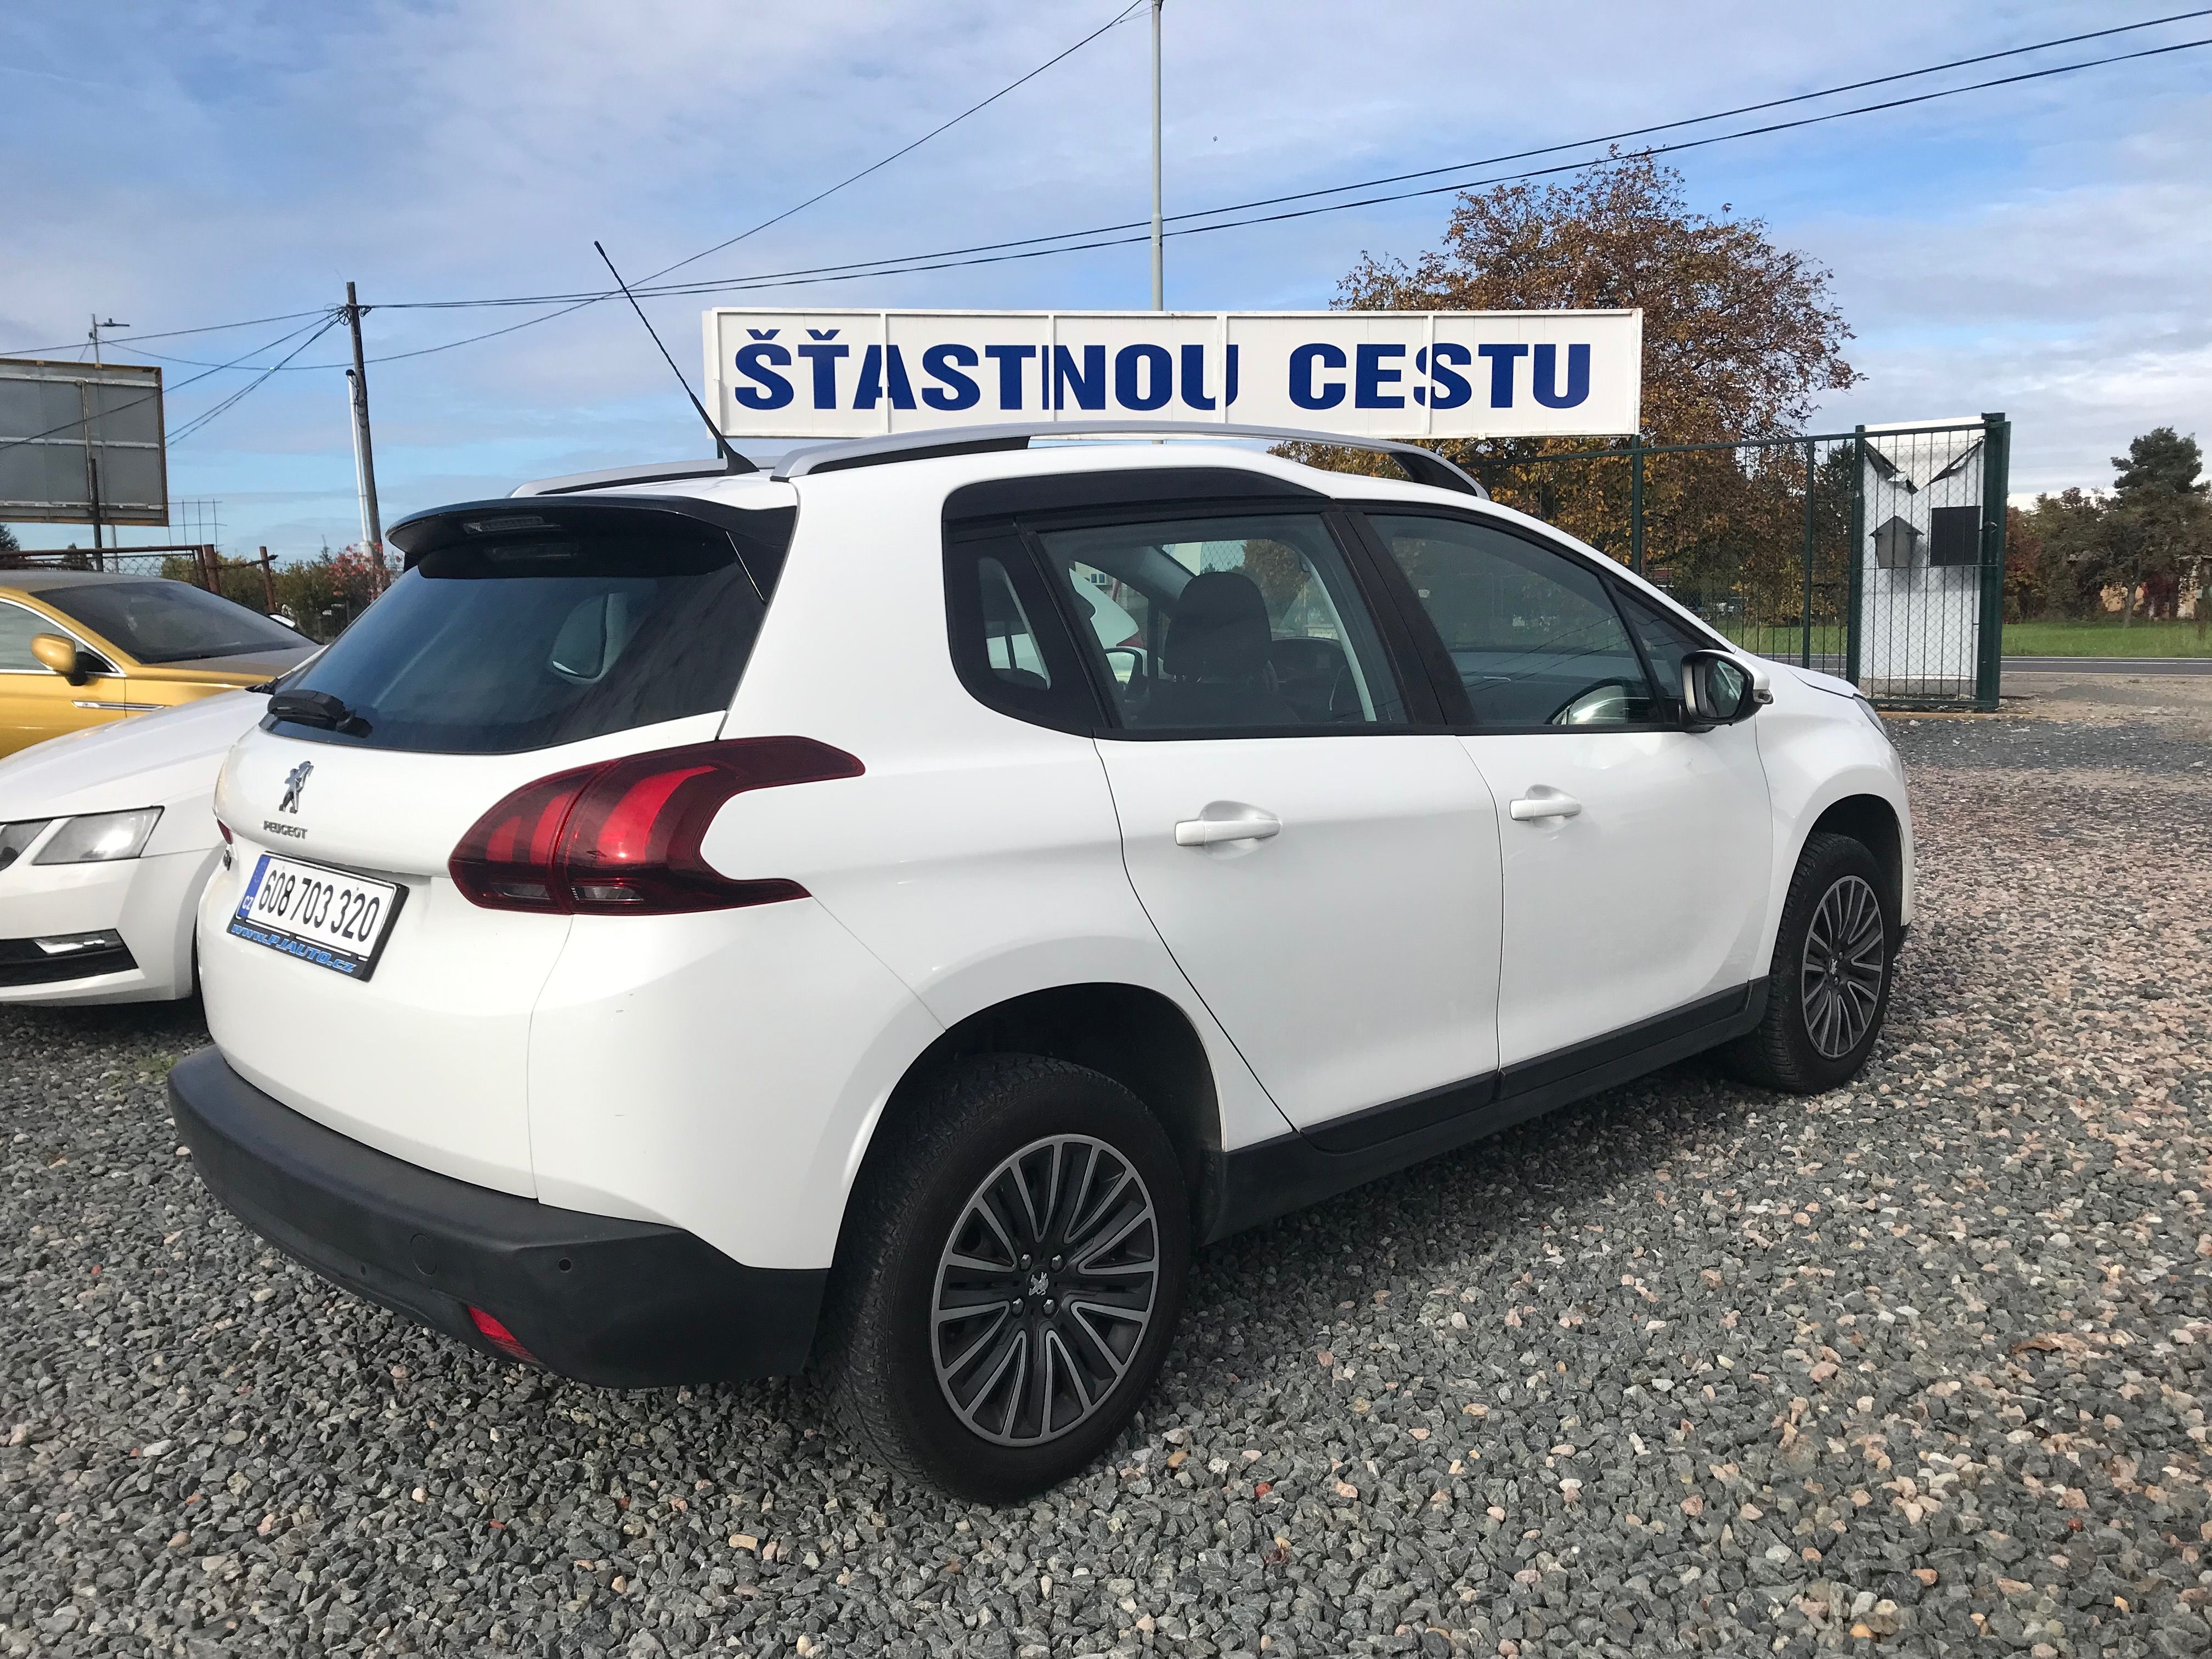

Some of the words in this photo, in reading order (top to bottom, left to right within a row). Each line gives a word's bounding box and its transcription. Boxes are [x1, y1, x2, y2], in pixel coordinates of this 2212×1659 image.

[736, 330, 1238, 410] ŠŤASTNOU
[1290, 343, 1589, 409] CESTU
[264, 820, 308, 839] PEUGEOT
[242, 896, 255, 910] CZ
[258, 870, 296, 916] 608
[290, 878, 334, 928] 703
[331, 889, 380, 942] 320
